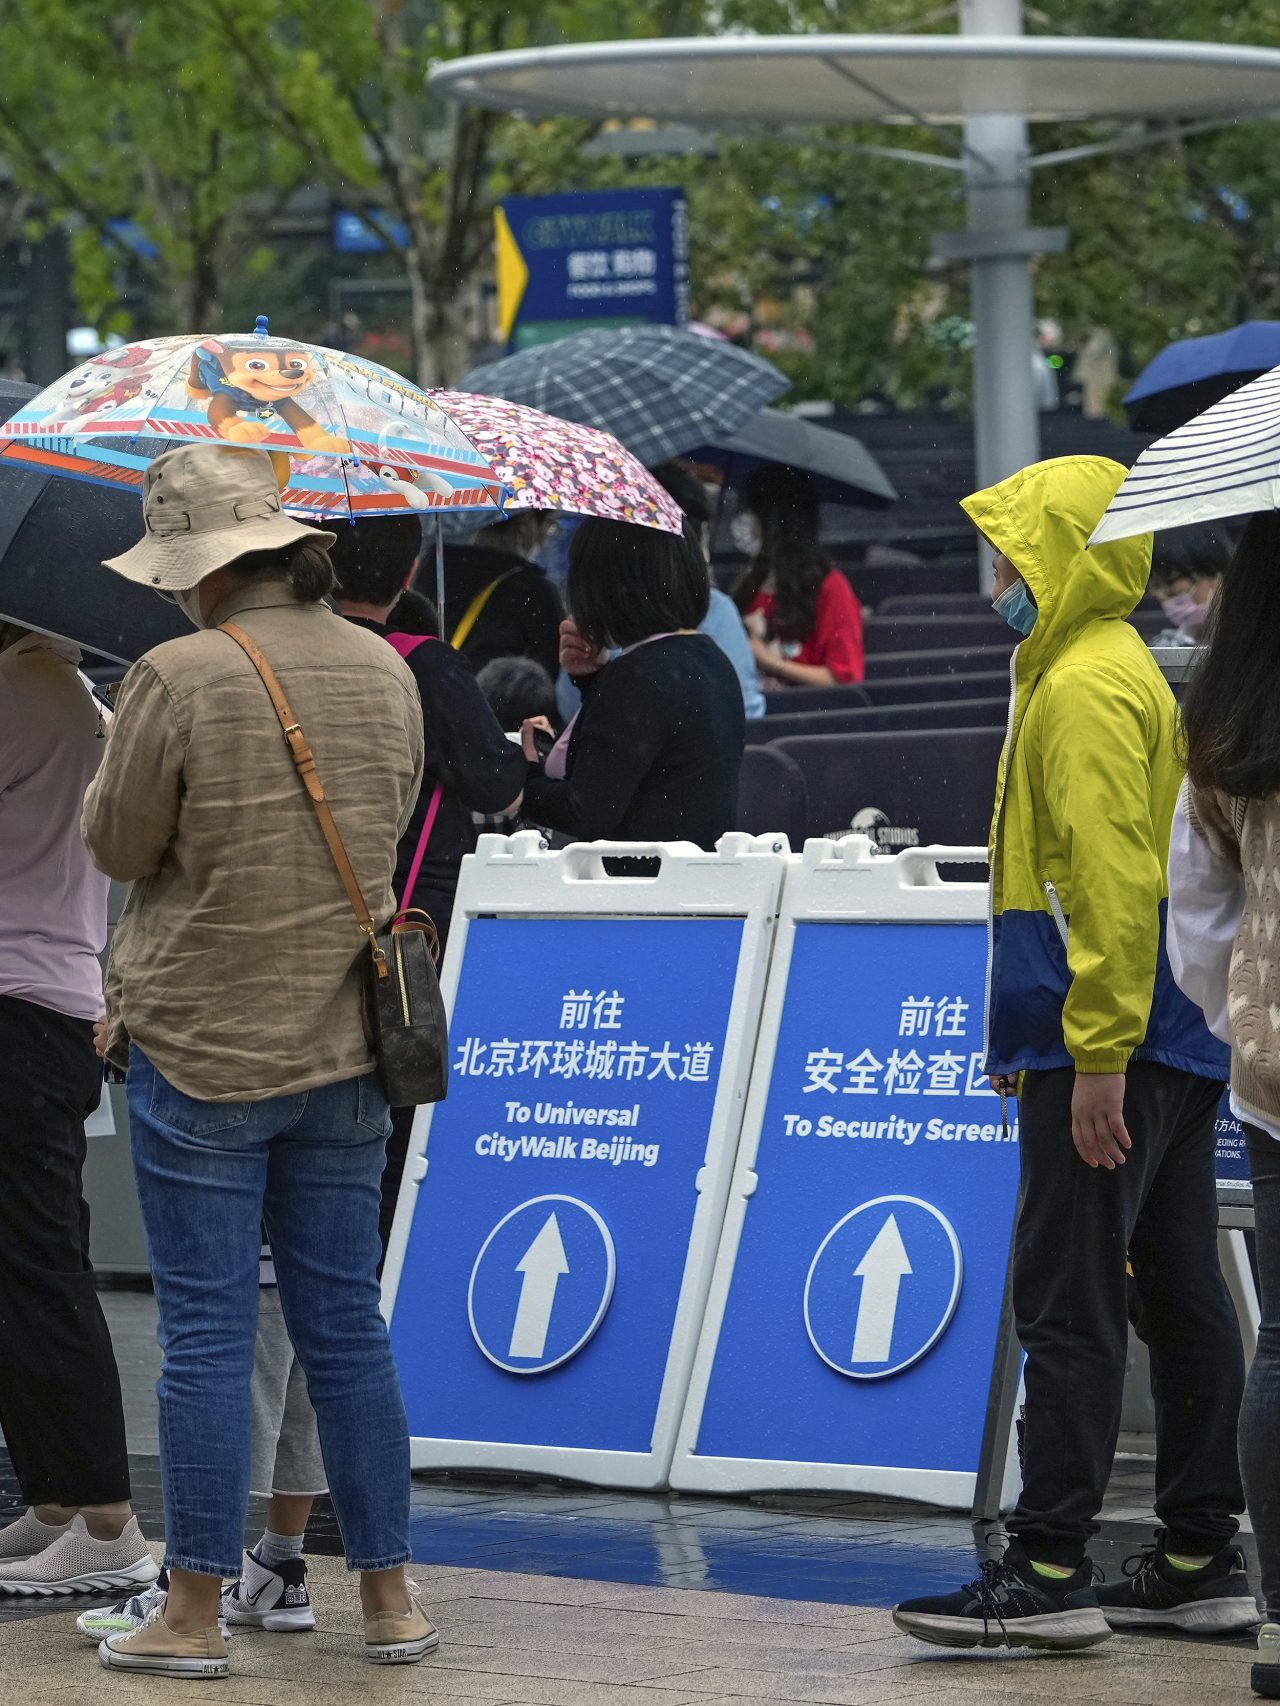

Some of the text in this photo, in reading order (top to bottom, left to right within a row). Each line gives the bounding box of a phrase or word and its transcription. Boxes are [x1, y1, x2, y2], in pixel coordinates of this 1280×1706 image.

[559, 989, 625, 1030] 前往
[898, 995, 969, 1037] 前往
[453, 1037, 714, 1082] 北京环球城市大道
[505, 1100, 640, 1127] To Universal
[783, 1114, 1019, 1146] To Security Screeni
[1217, 1139, 1239, 1147] EIJING
[475, 1132, 660, 1167] CityWalk Beijing
[1215, 1150, 1241, 1159] ATIONS.
[203, 1664, 213, 1674] ALL
